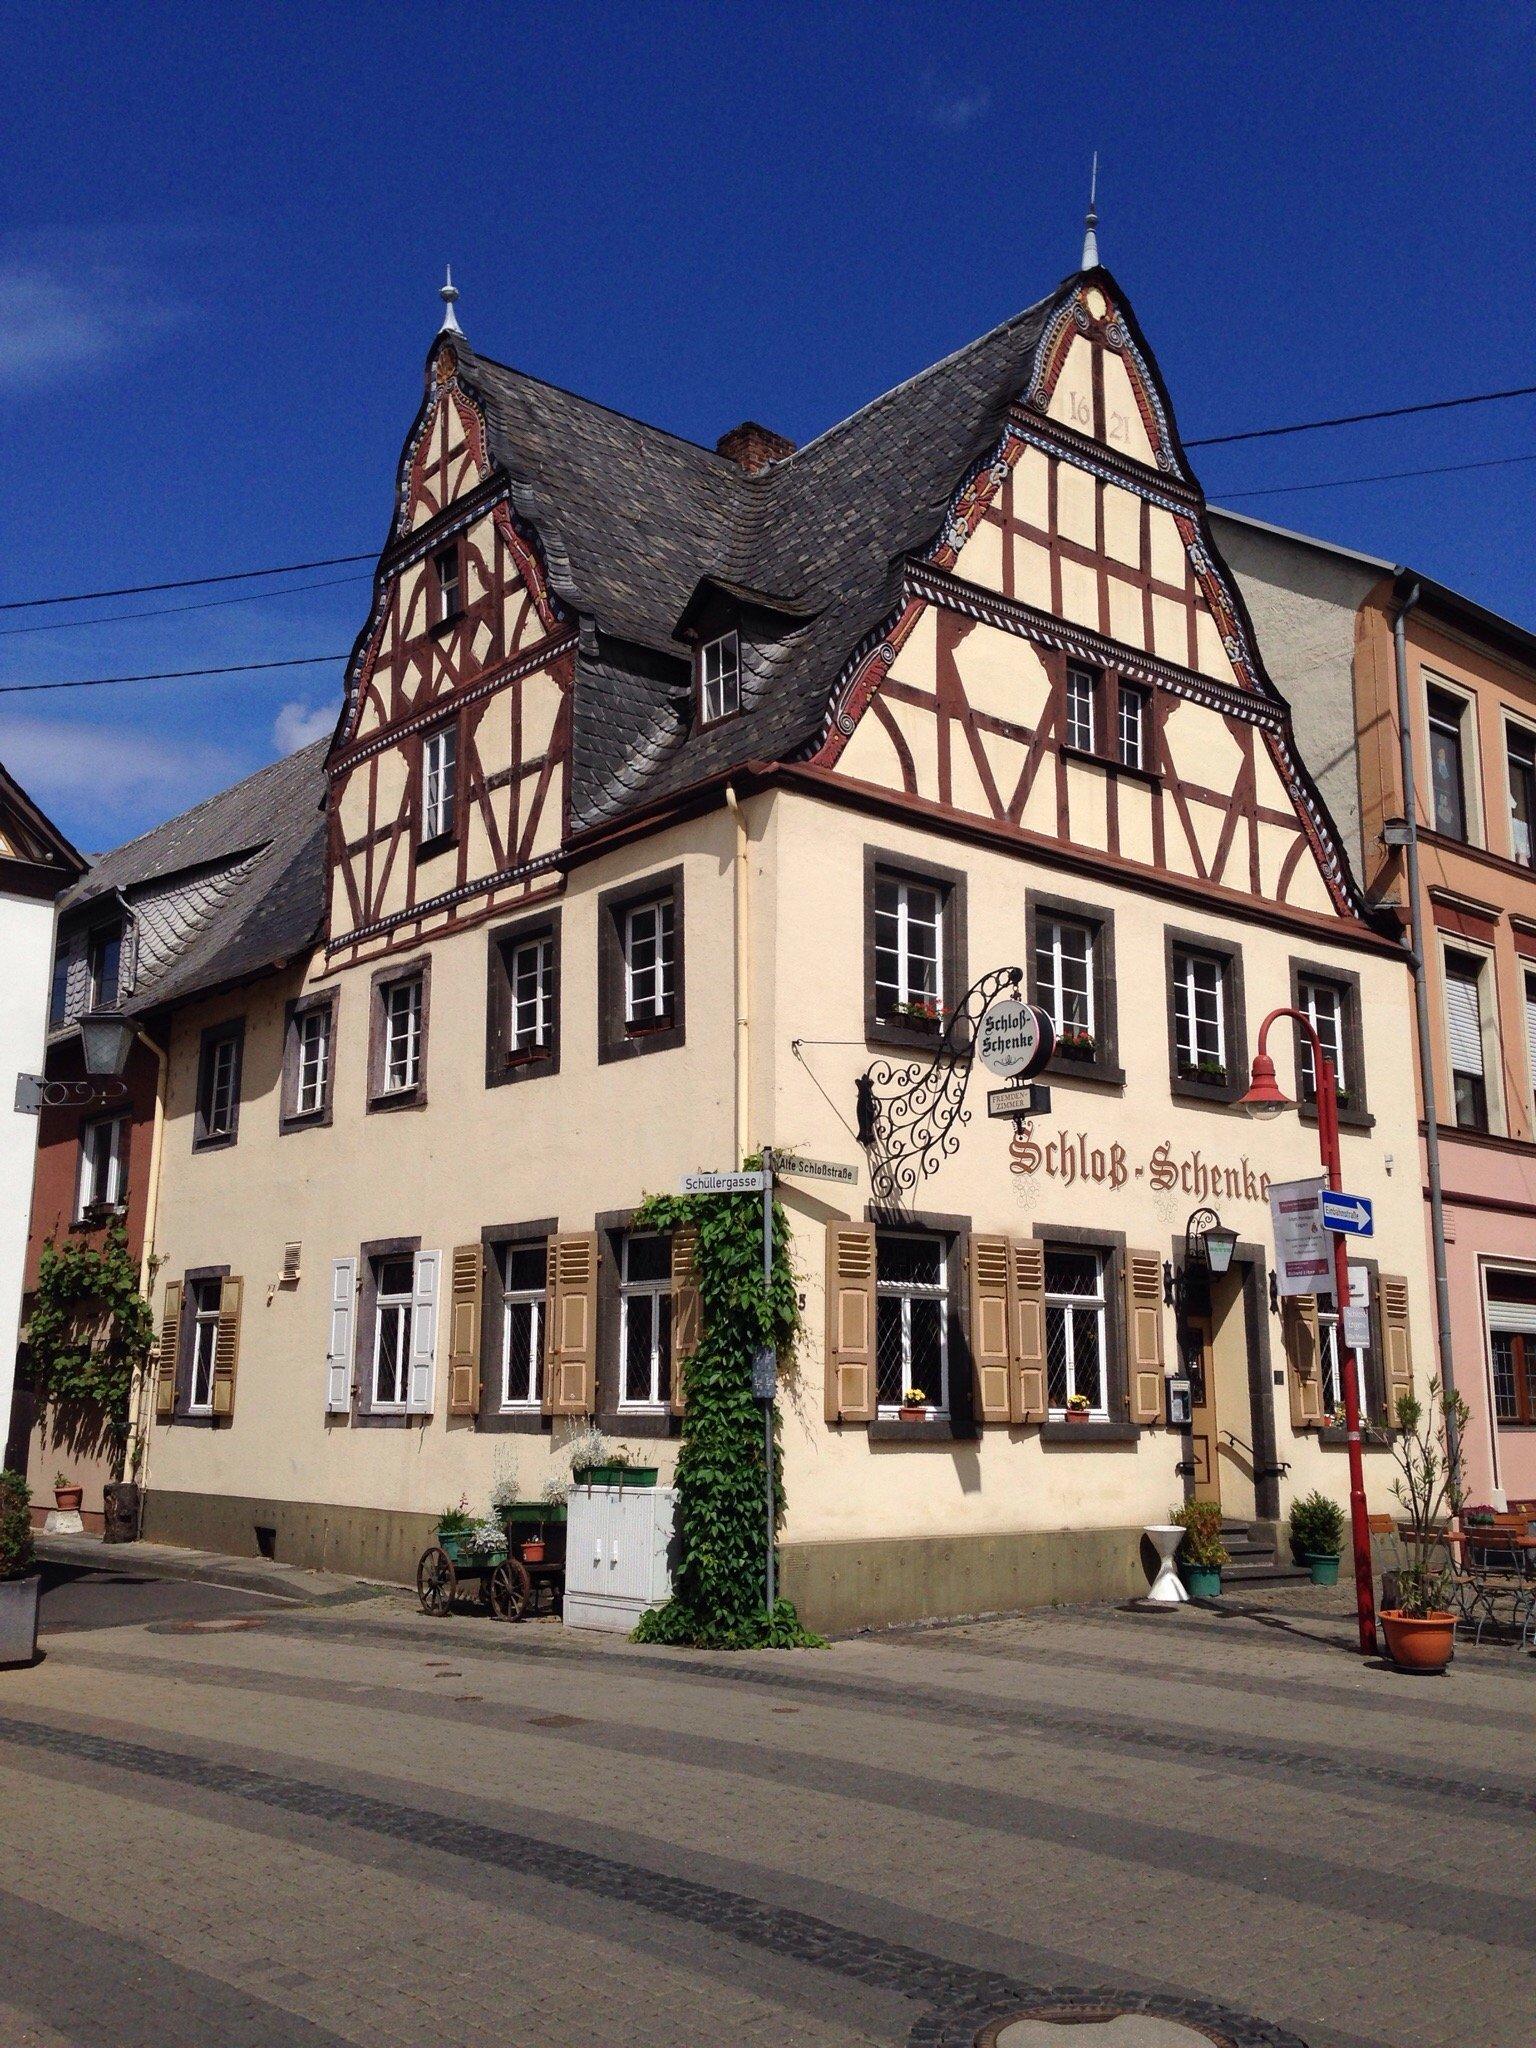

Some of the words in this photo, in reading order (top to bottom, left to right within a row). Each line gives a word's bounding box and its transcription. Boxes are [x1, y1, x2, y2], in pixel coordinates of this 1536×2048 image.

[1069, 390, 1090, 425] 16
[985, 1009, 1031, 1036] Schloß-
[982, 1032, 1034, 1058] Schenke
[992, 1090, 1028, 1103] FREMDEN-
[996, 1100, 1025, 1110] ZIMMER
[779, 1157, 796, 1171] Alte
[798, 1161, 853, 1180] Schloßstraße
[685, 1176, 757, 1191] Schüllergasse
[1325, 1205, 1359, 1221] Einbahnstraße
